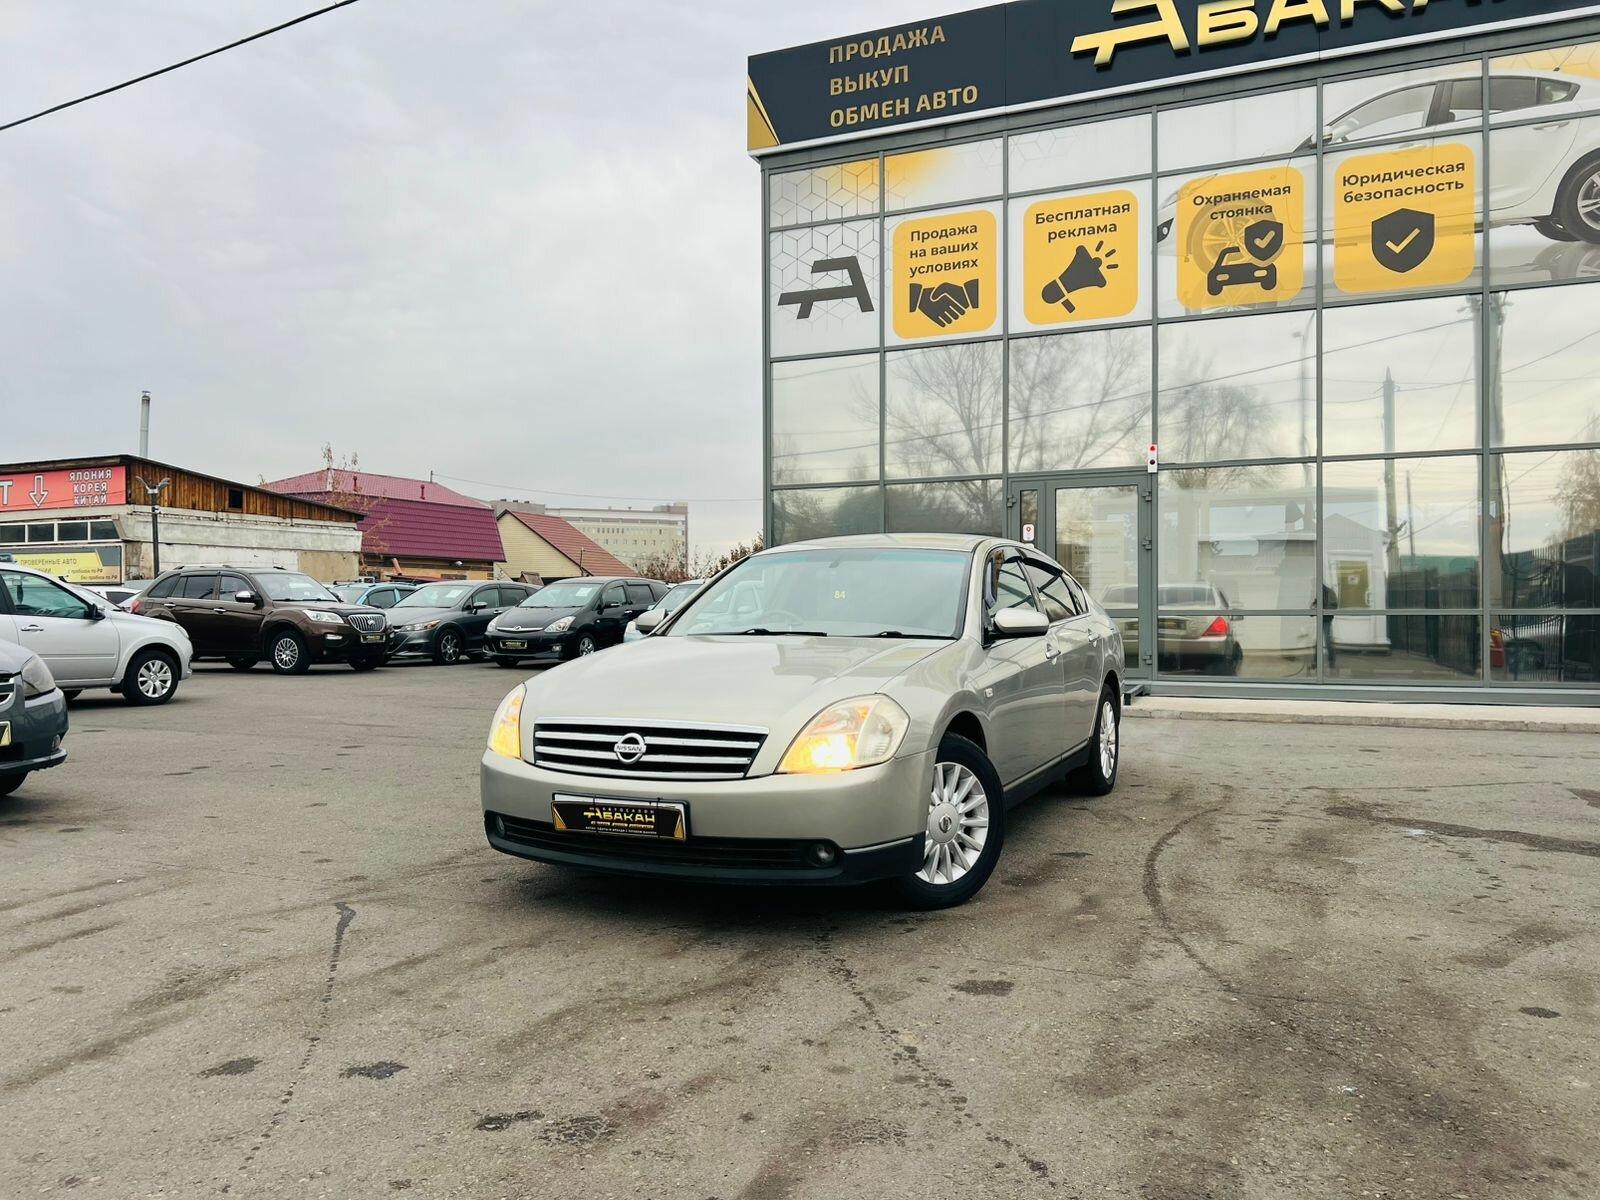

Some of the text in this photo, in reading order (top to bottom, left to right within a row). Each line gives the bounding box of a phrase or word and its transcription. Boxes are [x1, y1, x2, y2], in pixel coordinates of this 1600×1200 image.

[829, 25, 946, 64] ПРОДАЖА
[829, 65, 909, 96] ВЫКУП
[830, 85, 979, 128] ОБМЕН АВТО
[1342, 161, 1466, 188] Юридическая
[1193, 184, 1291, 207] Охраняемая
[1343, 179, 1465, 204] безопасность
[1035, 201, 1131, 226] Бесплатная
[1209, 203, 1273, 221] стоянка
[910, 223, 978, 243] Продажа
[1047, 222, 1118, 243] реклама
[909, 240, 979, 259] на ваших
[909, 258, 979, 278] условиях
[69, 469, 112, 481] ЯПОНИЯ
[73, 482, 107, 493] КОРЕЯ
[74, 492, 107, 505] КИТАЙ
